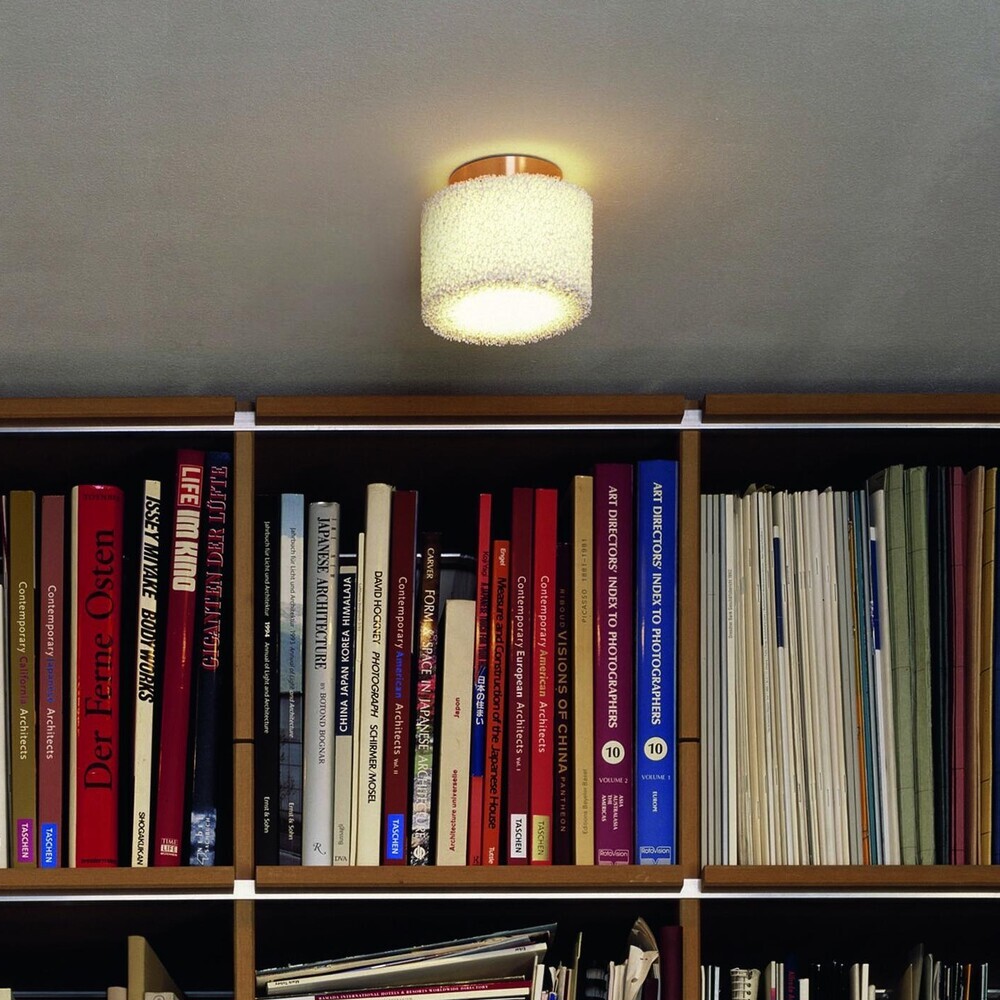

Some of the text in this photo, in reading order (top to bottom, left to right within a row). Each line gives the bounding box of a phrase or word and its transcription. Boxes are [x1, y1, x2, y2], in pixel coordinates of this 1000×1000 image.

[652, 482, 662, 504] ART
[138, 496, 160, 703] ISSEY MIYAKE BODYWORKS
[652, 573, 662, 606] INDEX
[652, 608, 662, 625] TO
[85, 530, 114, 790] Der Ferne Osten
[340, 576, 352, 732] CHINA JAPAN KOREA HIMALAJA
[368, 570, 382, 803] DAVID HOCKNEY PHOTOGRAPH SCHIRMER/MOSEL
[514, 576, 526, 754] Contemporary European Architects
[651, 628, 662, 726] PHOTOGRAPHERS
[606, 747, 620, 758] 10
[648, 743, 662, 754] 10
